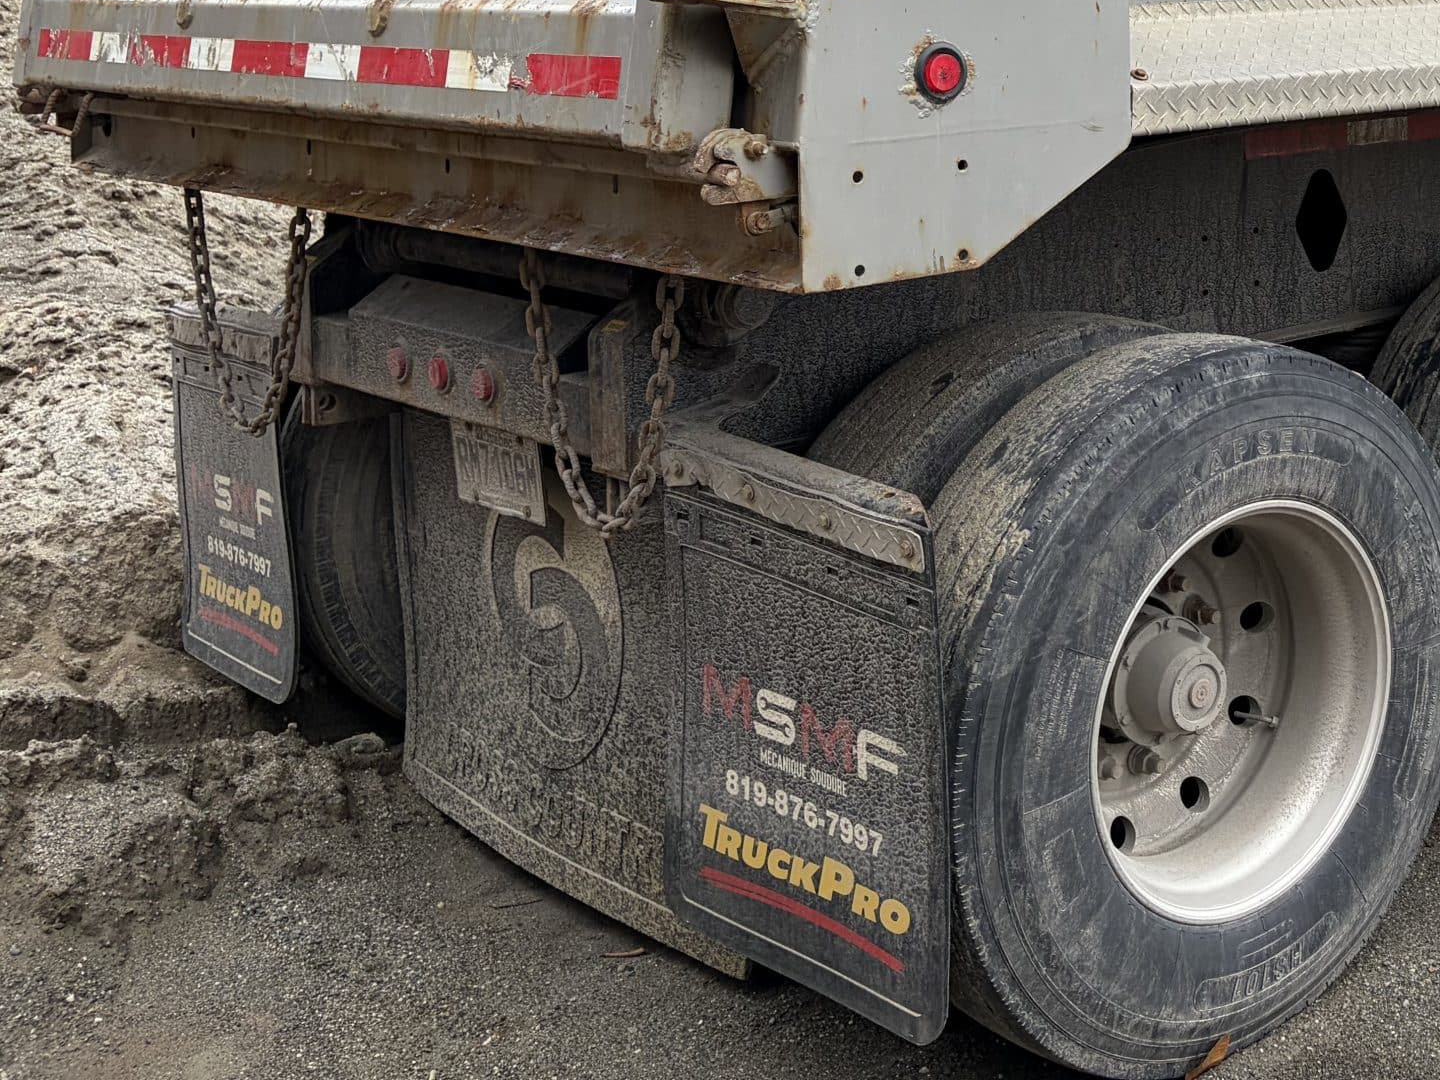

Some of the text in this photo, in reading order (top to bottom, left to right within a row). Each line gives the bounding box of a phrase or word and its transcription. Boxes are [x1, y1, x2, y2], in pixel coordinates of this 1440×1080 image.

[1178, 428, 1316, 494] KAPSEN
[208, 535, 271, 578] 819-876-7997
[703, 664, 907, 781] MSMF
[726, 770, 883, 856] 819-876-7997
[810, 767, 849, 797] SOUDURE
